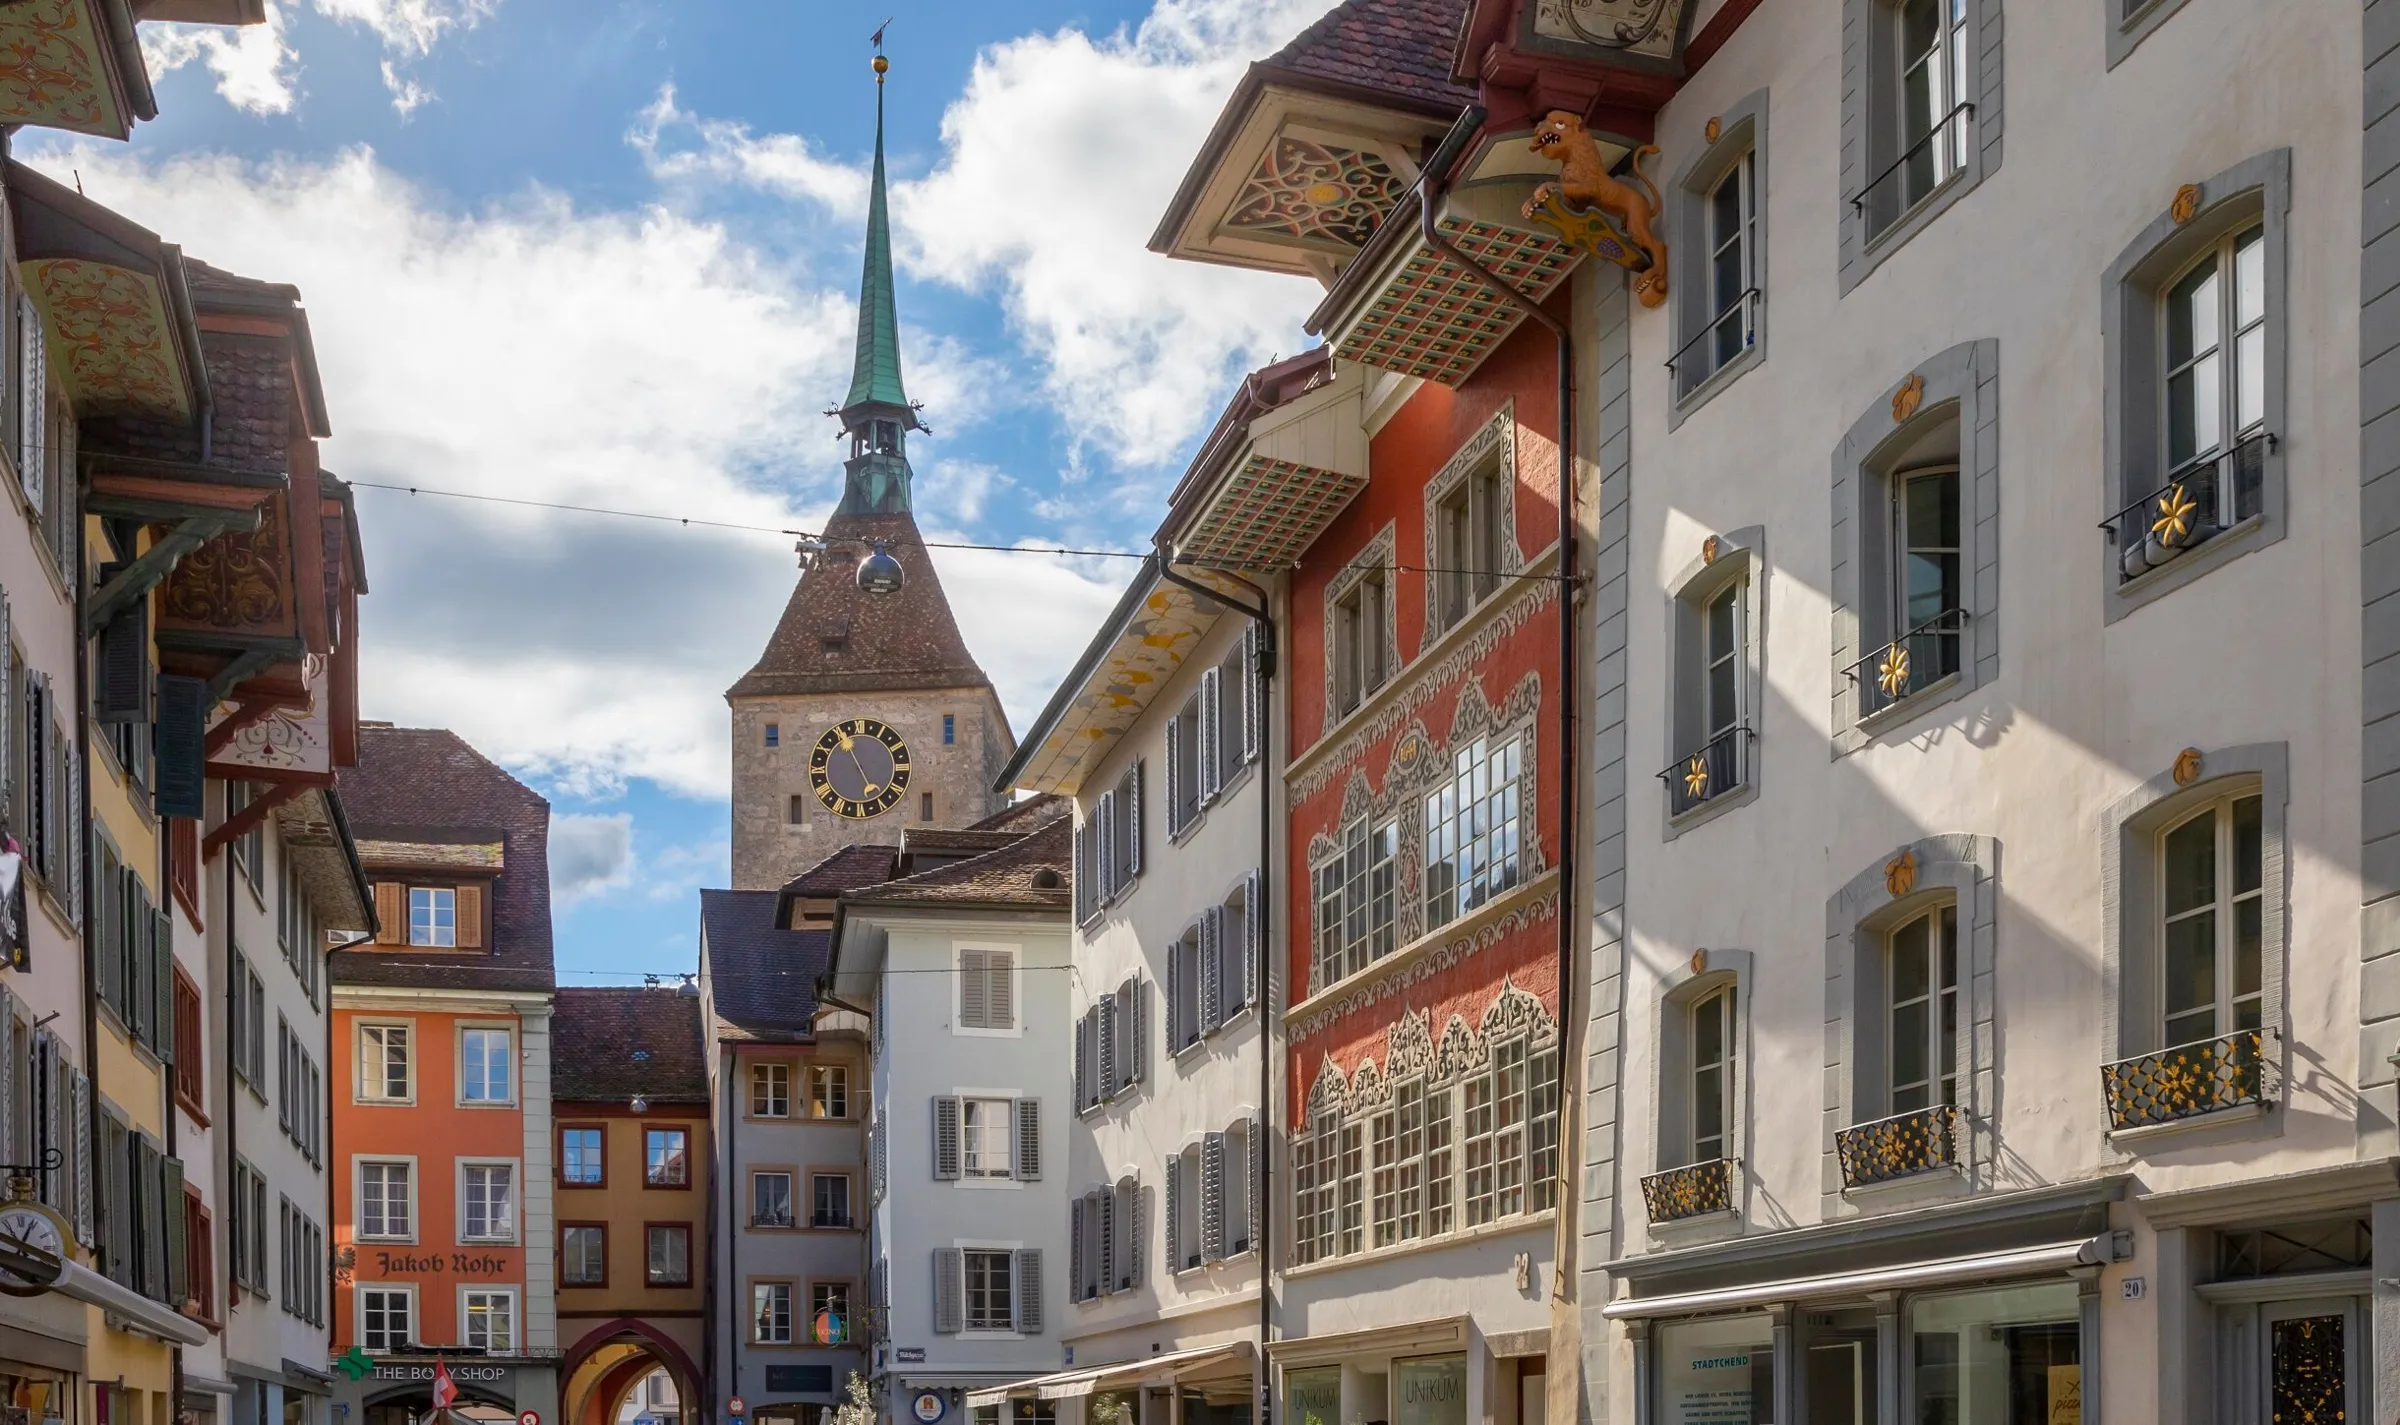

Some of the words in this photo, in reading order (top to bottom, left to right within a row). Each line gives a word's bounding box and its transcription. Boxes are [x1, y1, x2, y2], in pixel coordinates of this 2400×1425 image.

[816, 743, 831, 755] X
[376, 1252, 444, 1278] Jakob
[2125, 1282, 2139, 1298] 20
[373, 1366, 404, 1379] THE
[411, 1366, 457, 1380] BOY
[461, 1367, 505, 1380] SHOP
[1294, 1387, 1336, 1410] UNIKUM
[1405, 1377, 1459, 1404] UNIKUM
